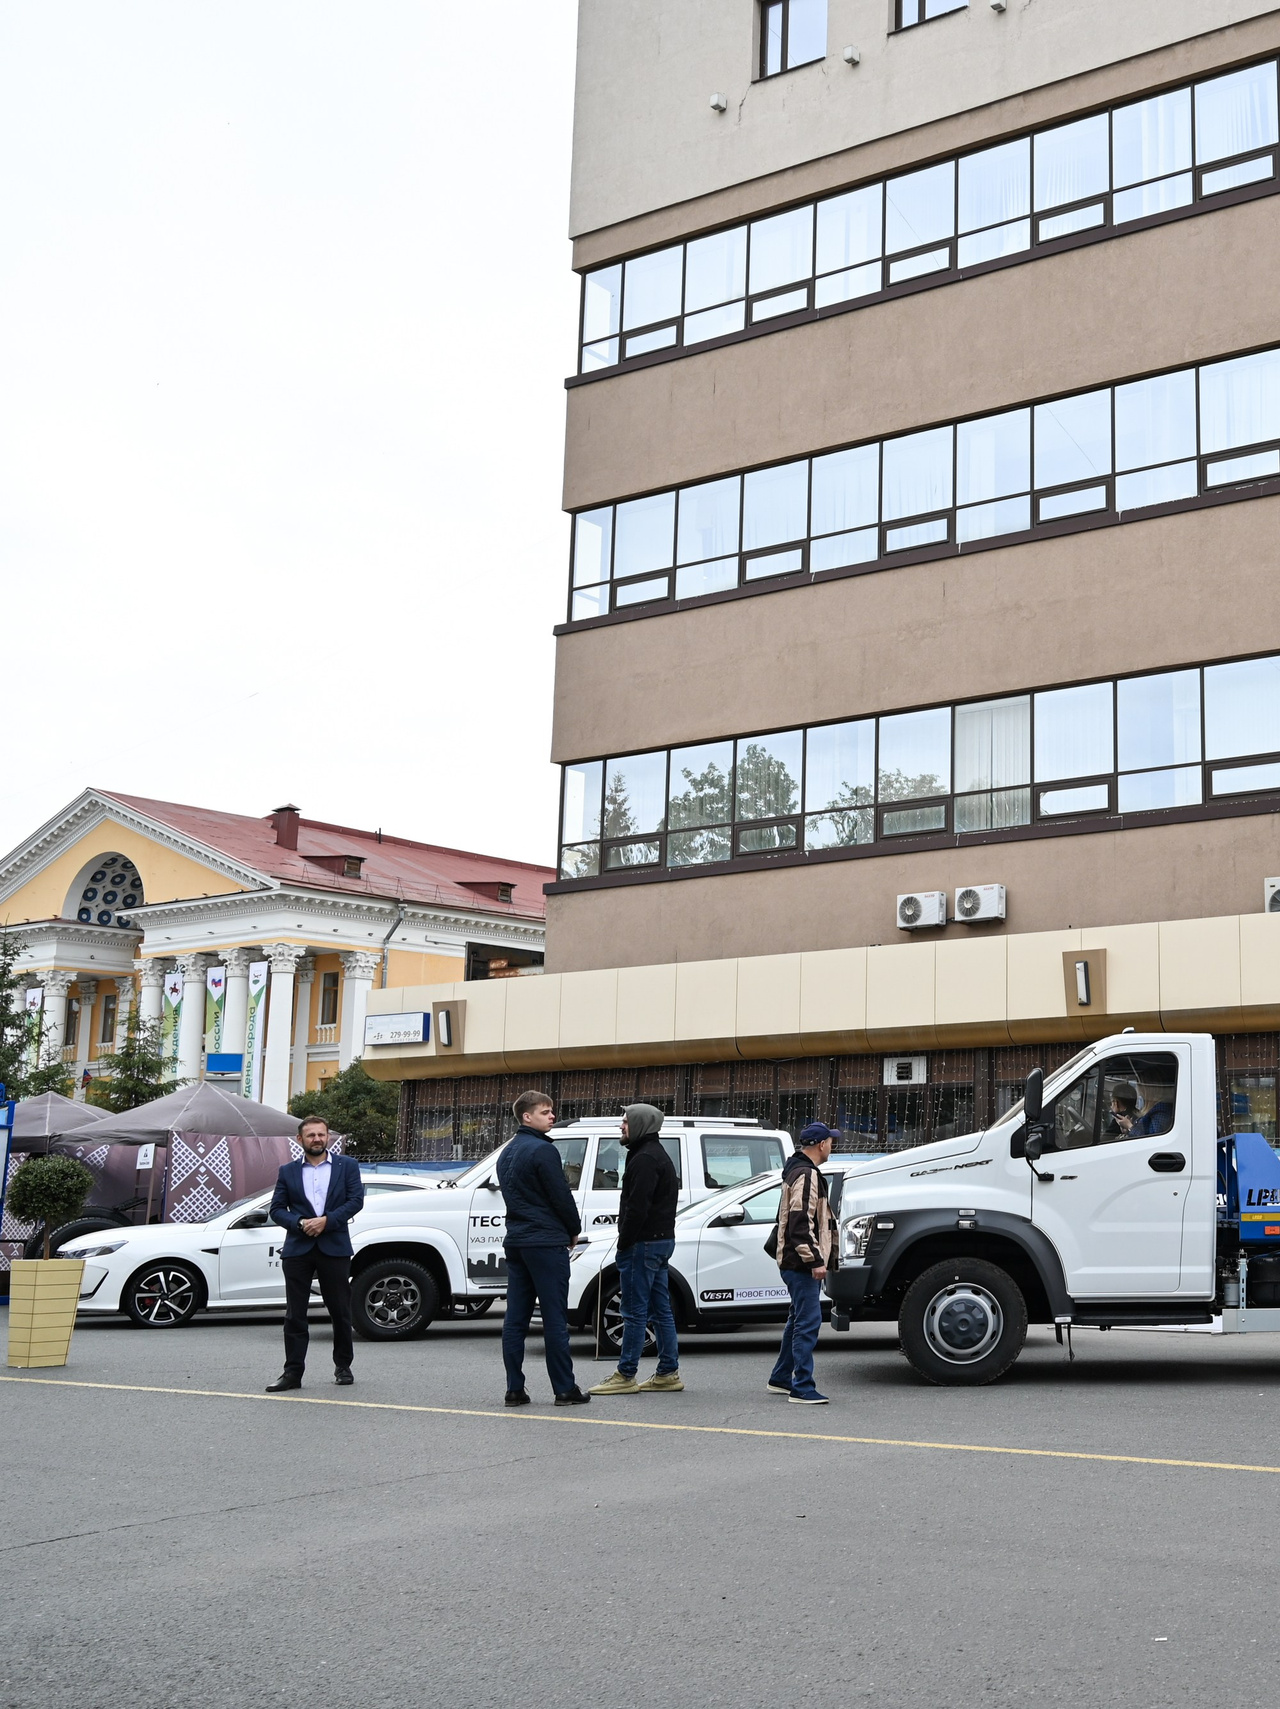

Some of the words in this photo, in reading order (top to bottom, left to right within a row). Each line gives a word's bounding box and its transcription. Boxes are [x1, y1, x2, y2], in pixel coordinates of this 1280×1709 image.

[470, 1236, 486, 1244] УАЗ
[703, 1291, 732, 1300] VESTA
[736, 1290, 763, 1298] НОВОЕ
